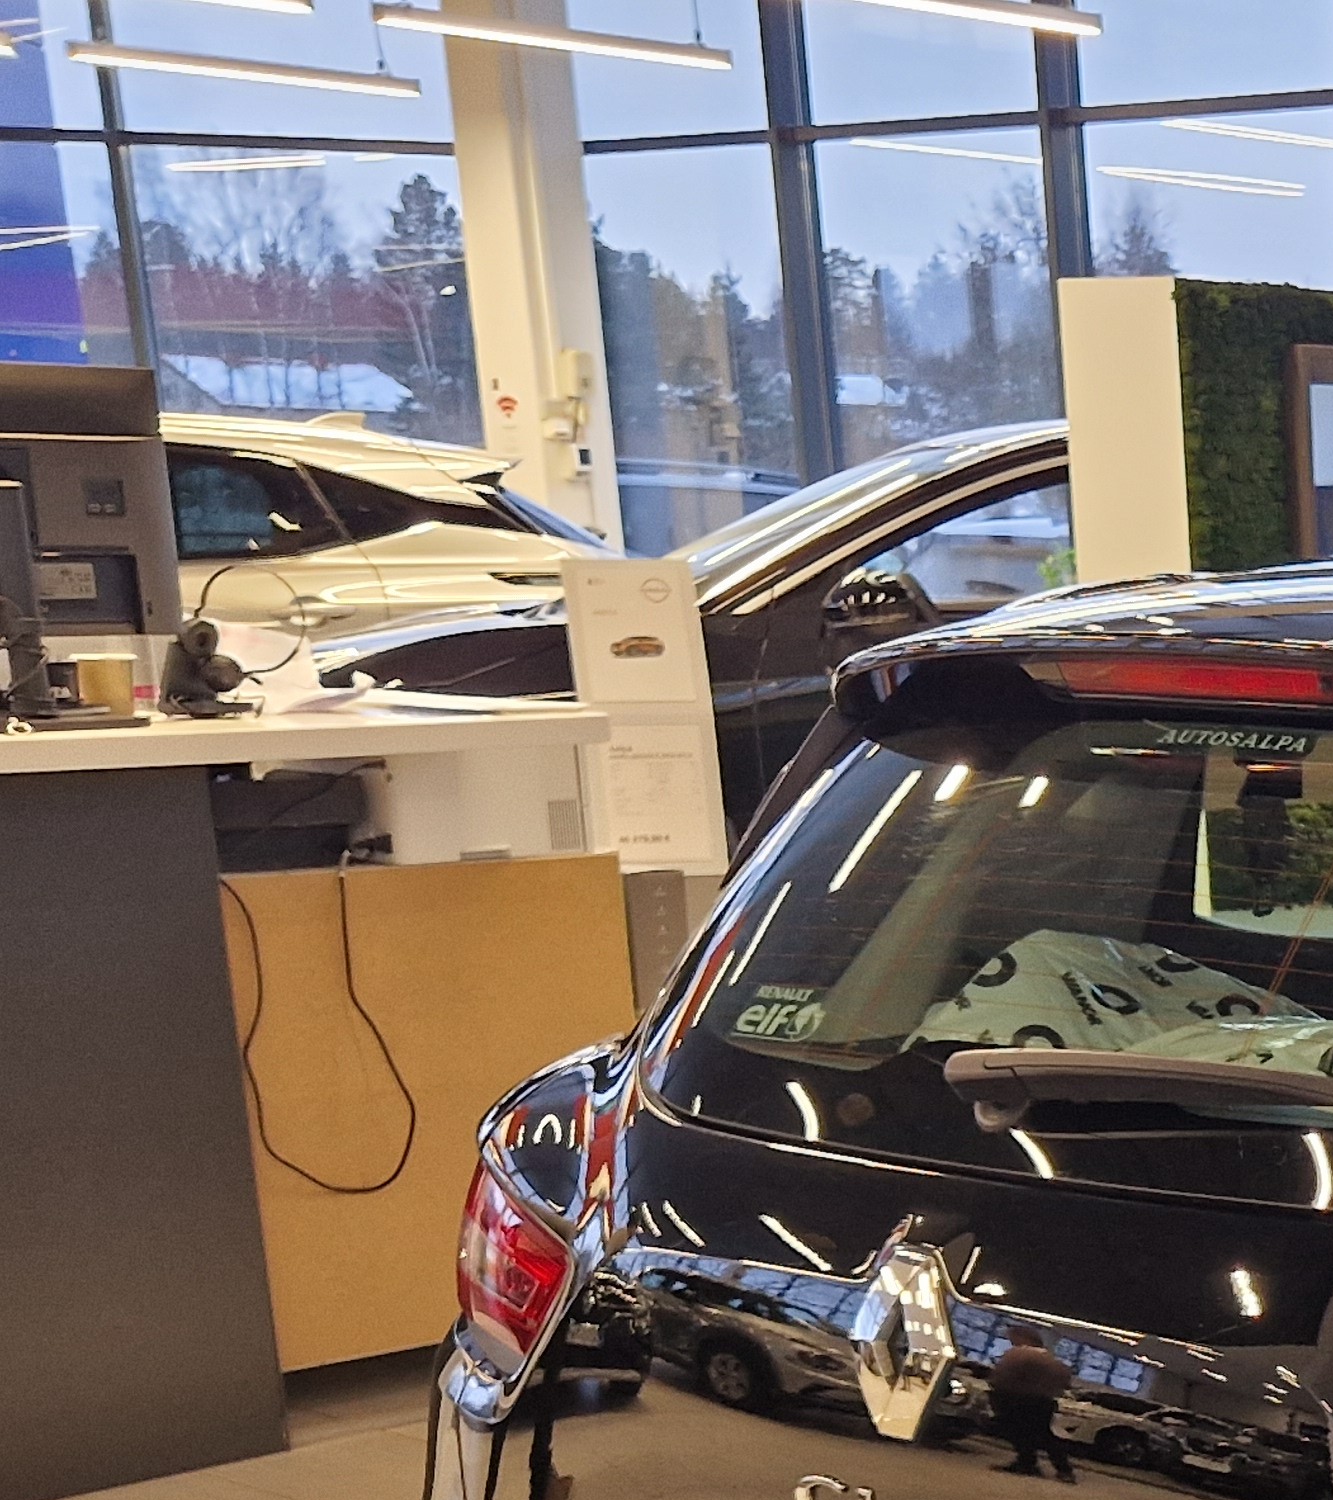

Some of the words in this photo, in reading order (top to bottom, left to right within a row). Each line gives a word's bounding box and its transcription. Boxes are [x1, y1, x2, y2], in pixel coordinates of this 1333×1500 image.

[1156, 728, 1308, 753] AUTOSALPA
[756, 985, 815, 1002] RENAULT
[734, 1003, 799, 1036] elf
